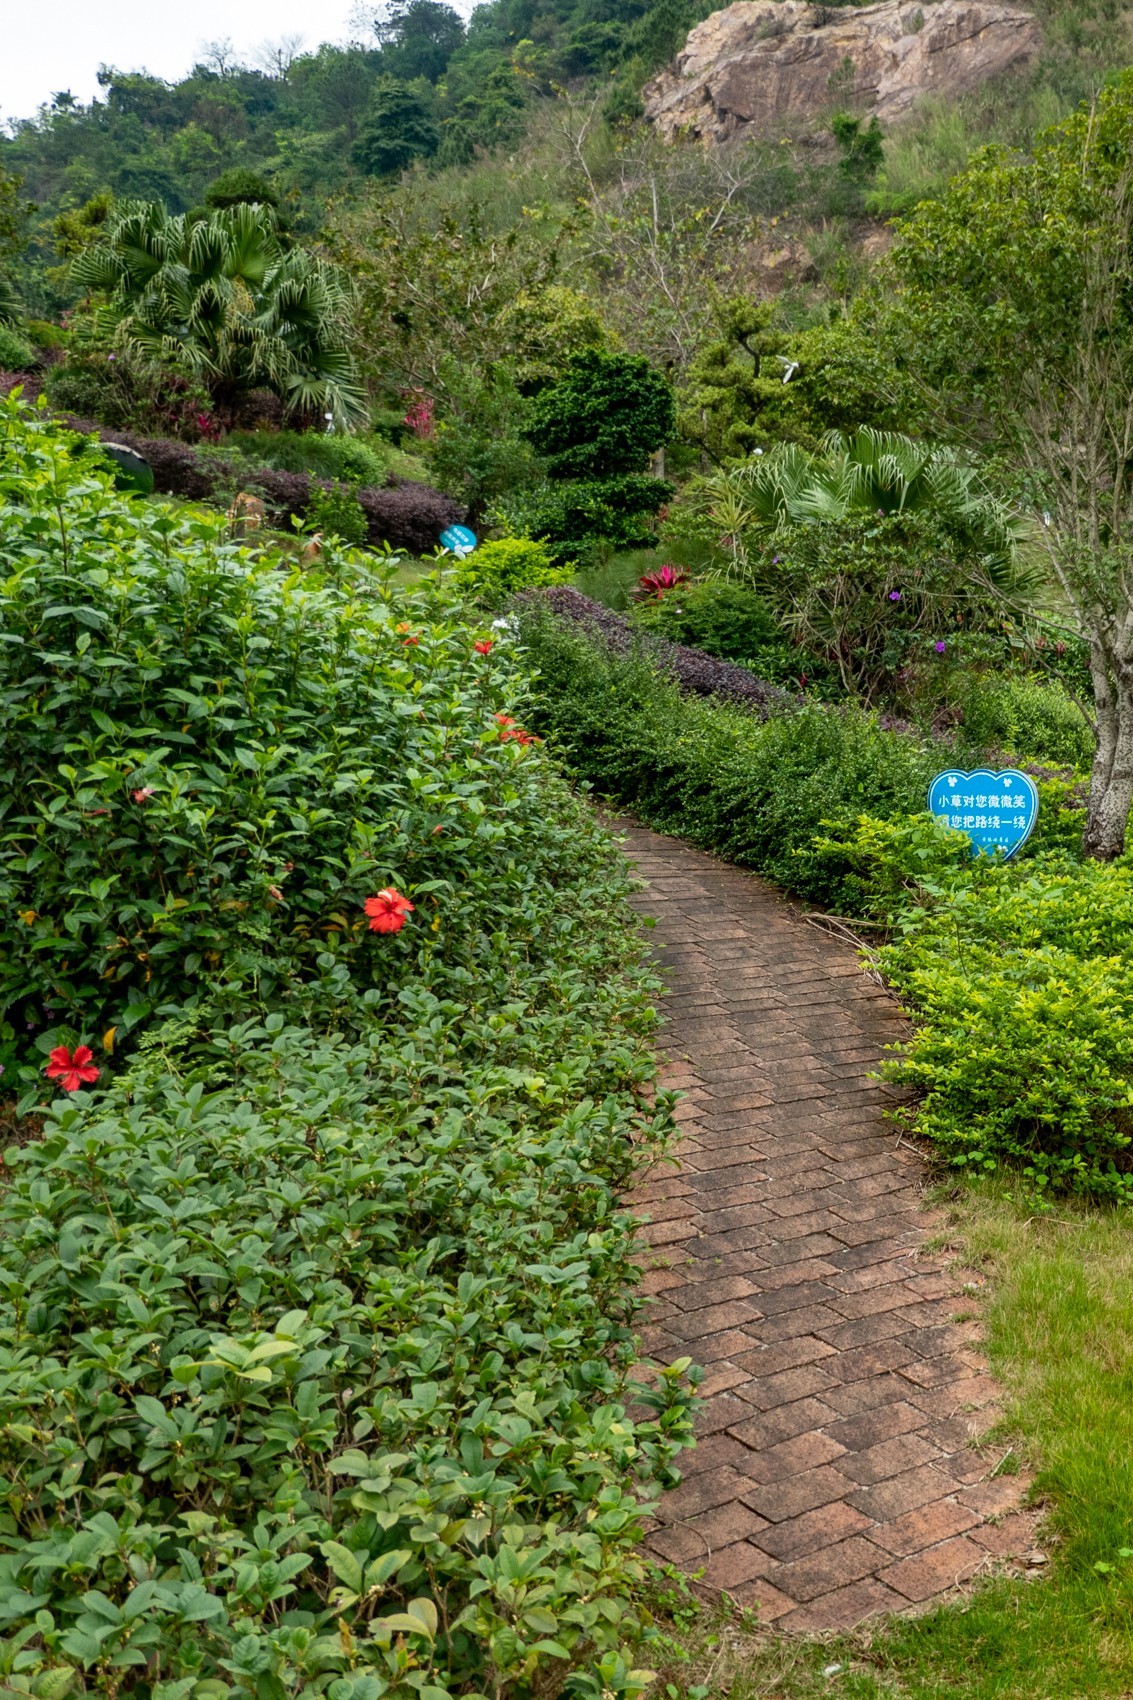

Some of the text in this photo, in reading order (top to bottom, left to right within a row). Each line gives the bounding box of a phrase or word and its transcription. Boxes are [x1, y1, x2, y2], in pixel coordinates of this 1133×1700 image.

[938, 795, 1026, 808] 小草对您微微笑
